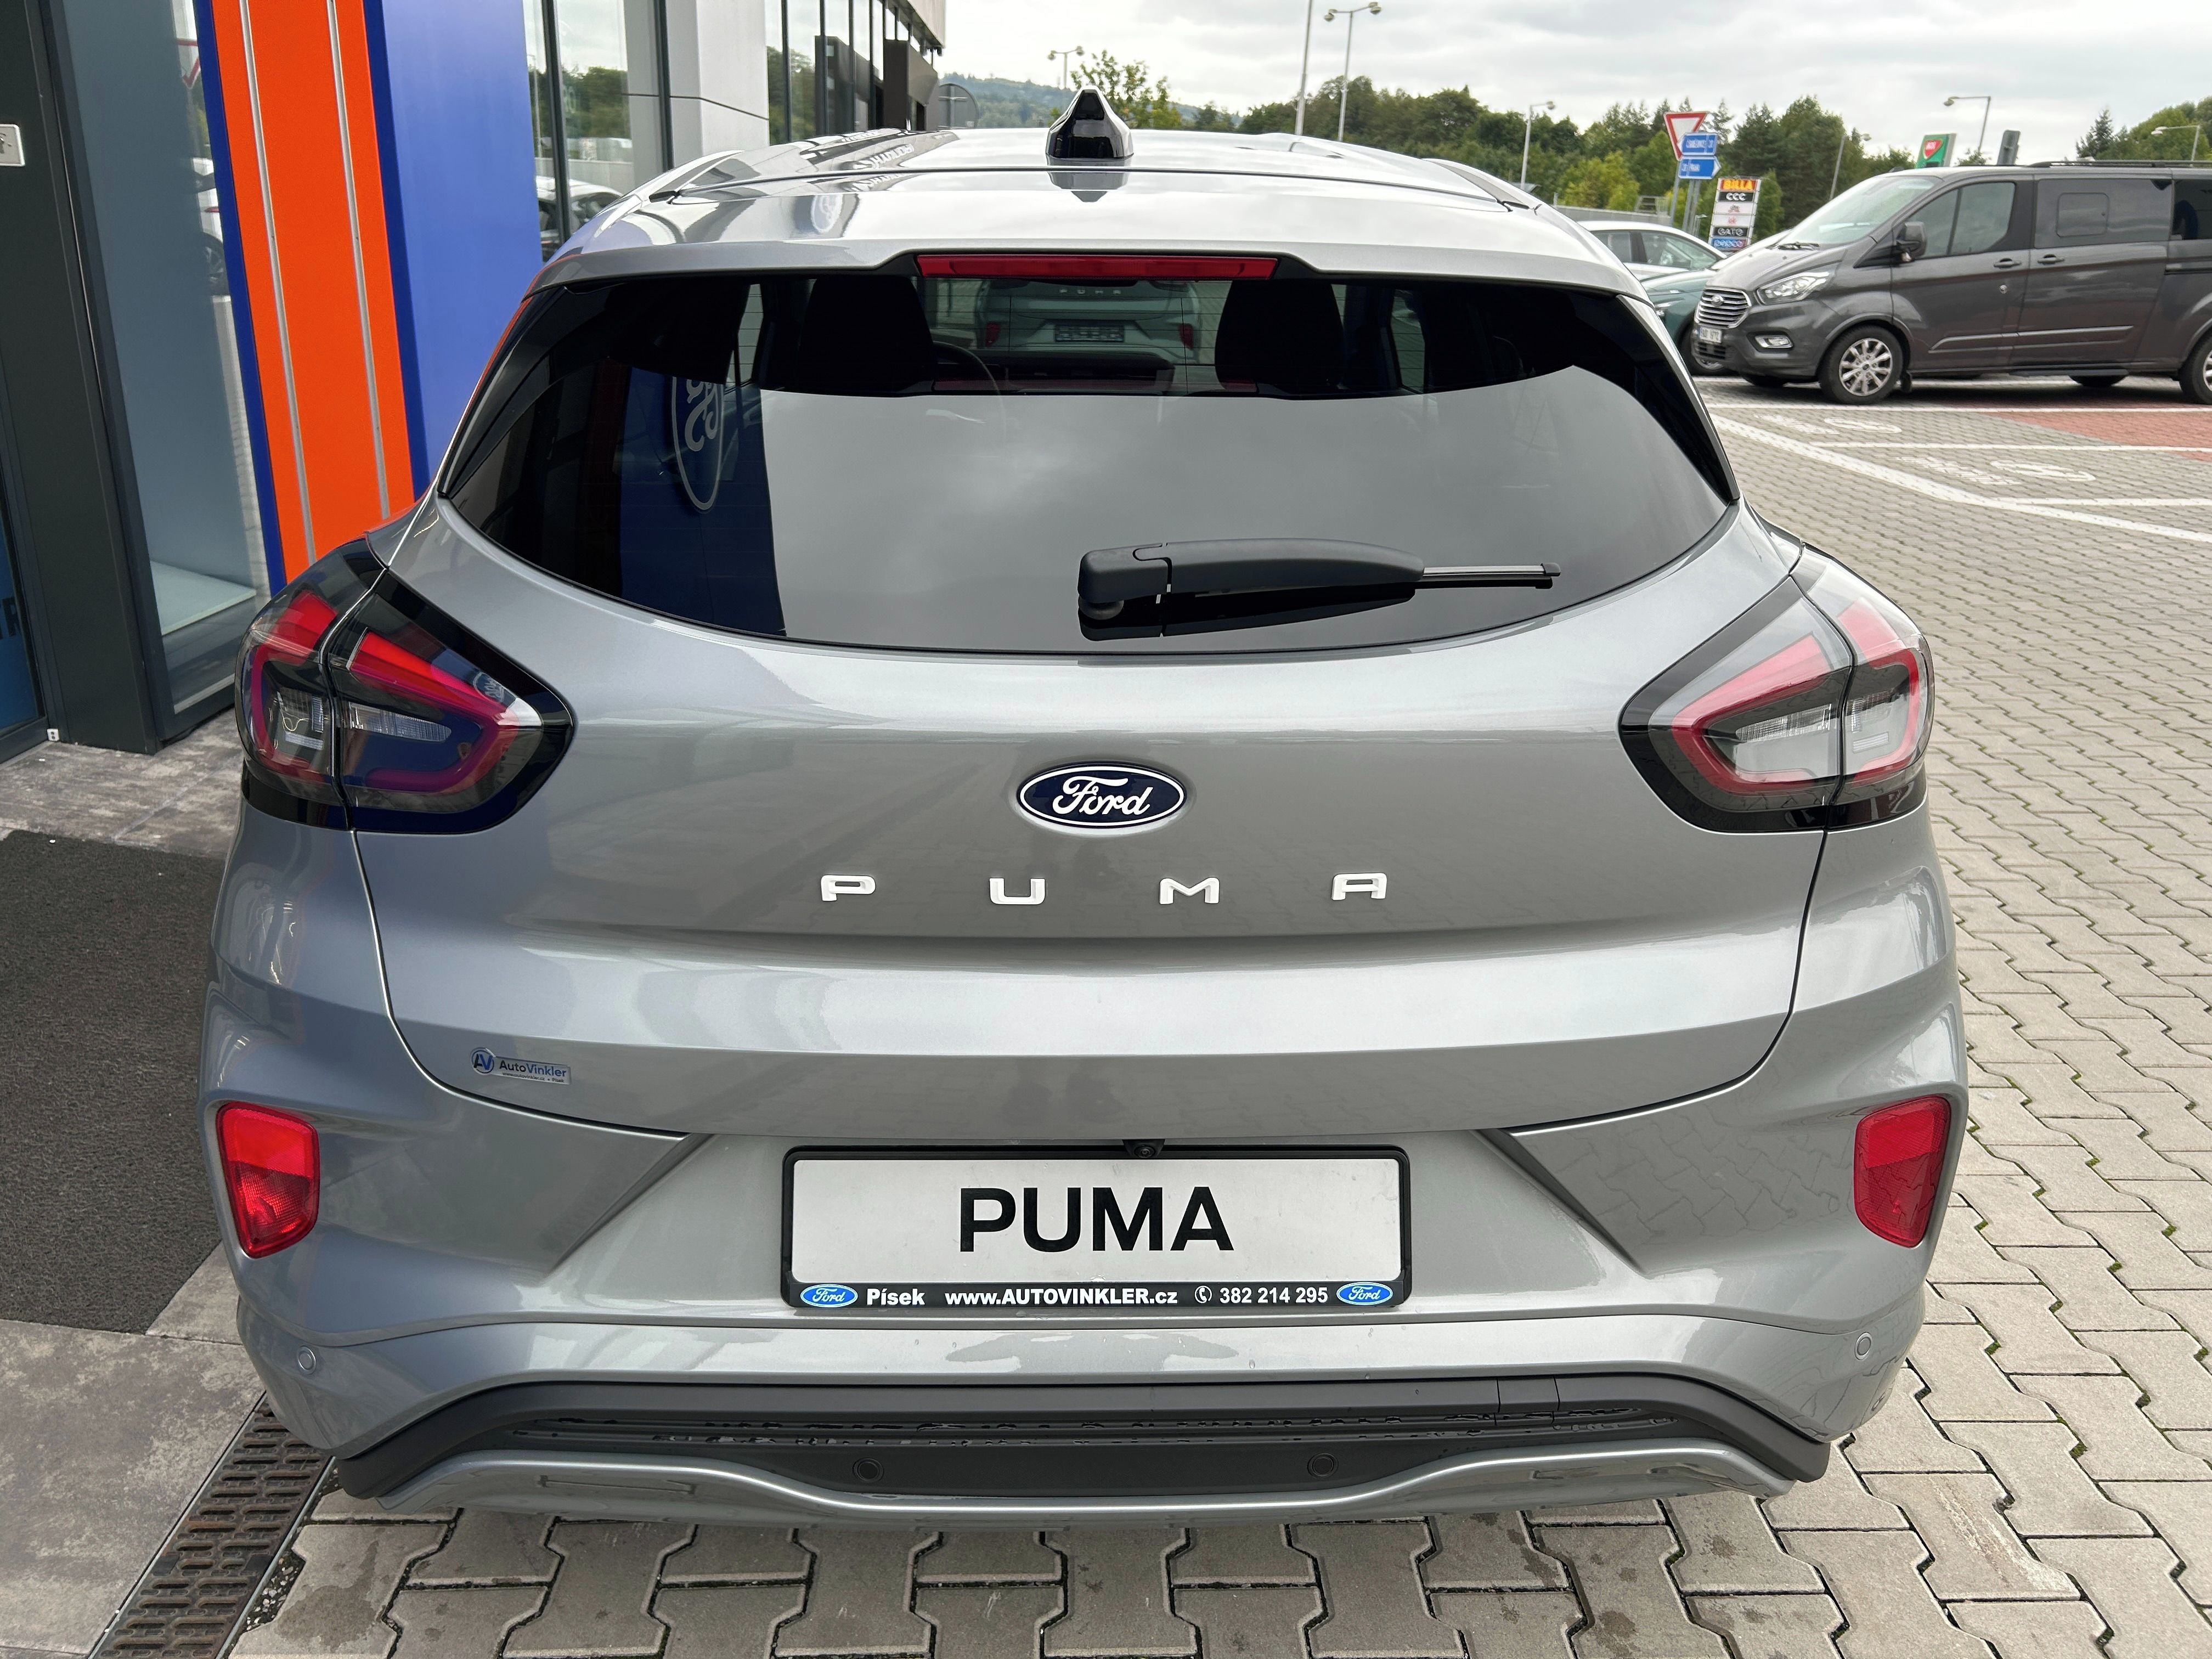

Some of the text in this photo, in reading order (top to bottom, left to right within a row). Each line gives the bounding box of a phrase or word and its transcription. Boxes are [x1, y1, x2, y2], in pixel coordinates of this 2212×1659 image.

[1726, 193, 1746, 201] CCC
[1052, 776, 1153, 815] Ford
[821, 874, 1387, 905] PUMA
[499, 1059, 567, 1077] AutoVinkler
[960, 1187, 1234, 1252] PUMA
[812, 1286, 1381, 1305] Ford Písek www.AUTOVINKLER.cz 382 214 295 Ford
